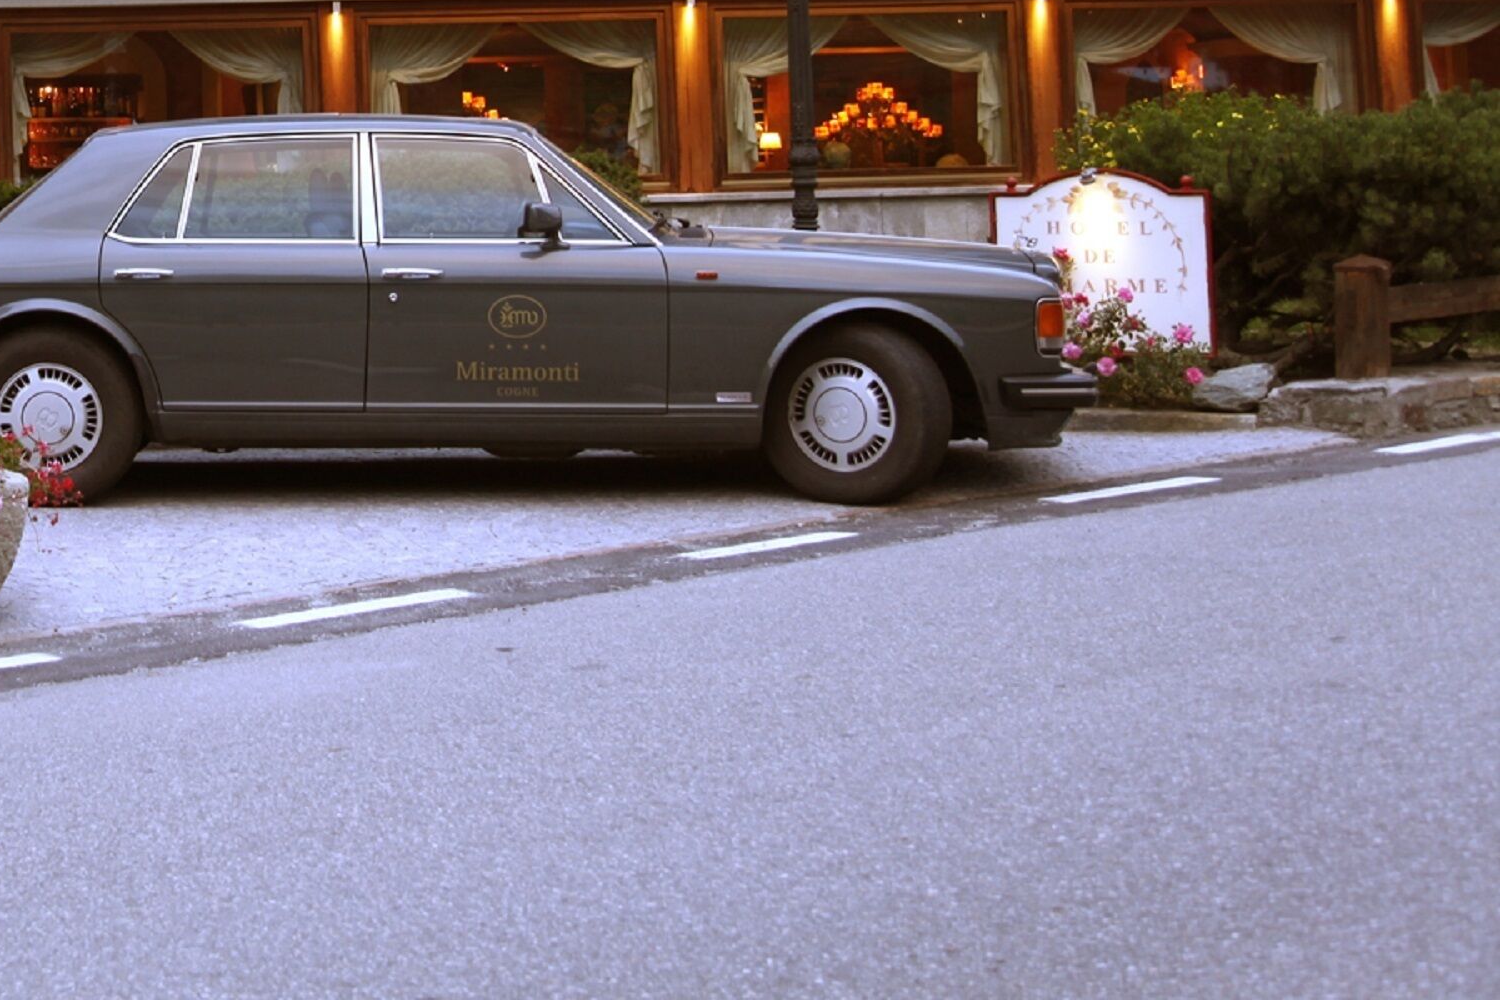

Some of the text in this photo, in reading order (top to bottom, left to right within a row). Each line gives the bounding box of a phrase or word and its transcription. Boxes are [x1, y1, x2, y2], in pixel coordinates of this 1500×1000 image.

[1046, 220, 1153, 236] HOEL
[1084, 248, 1116, 264] DE
[1062, 277, 1168, 295] ARME
[455, 359, 580, 382] Miramonti
[496, 386, 539, 397] COGNE
